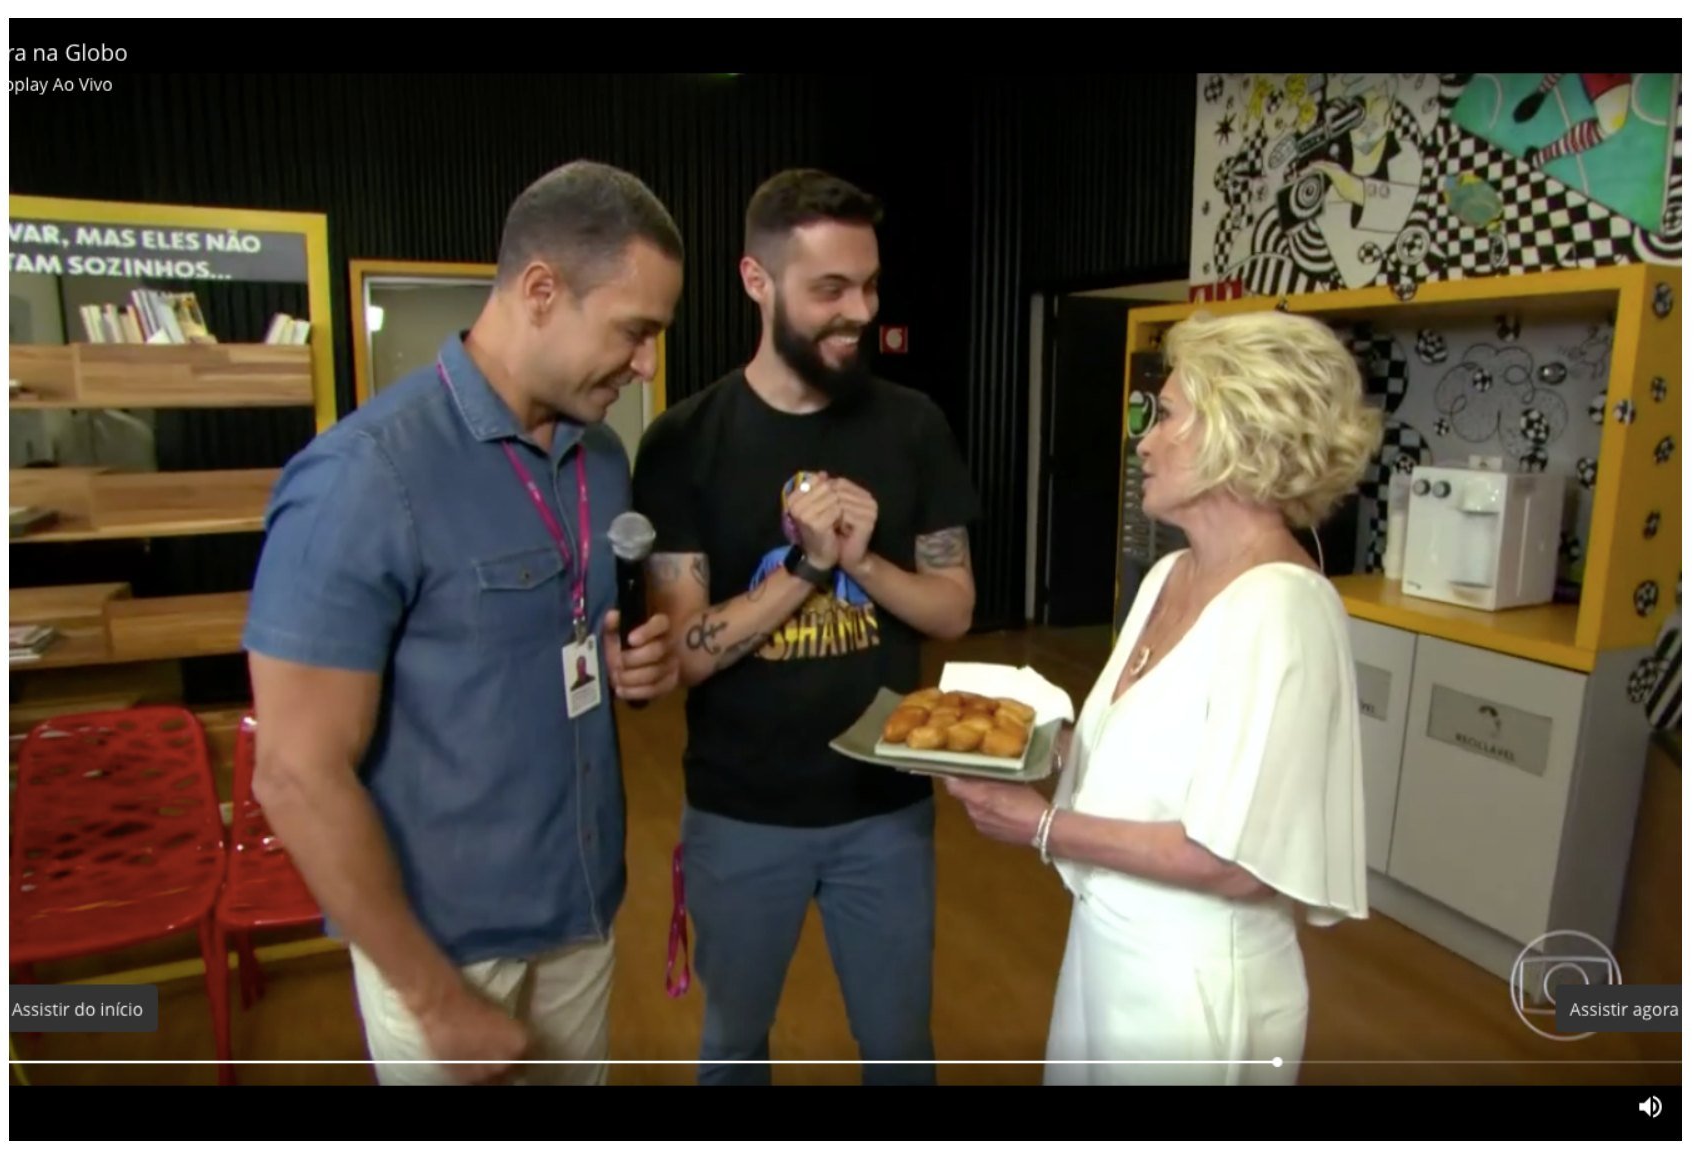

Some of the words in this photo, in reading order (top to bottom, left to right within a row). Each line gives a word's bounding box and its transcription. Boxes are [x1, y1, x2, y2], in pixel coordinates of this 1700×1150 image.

[76, 227, 136, 248] MAS
[142, 229, 200, 250] ELES
[206, 229, 262, 253] NÃO
